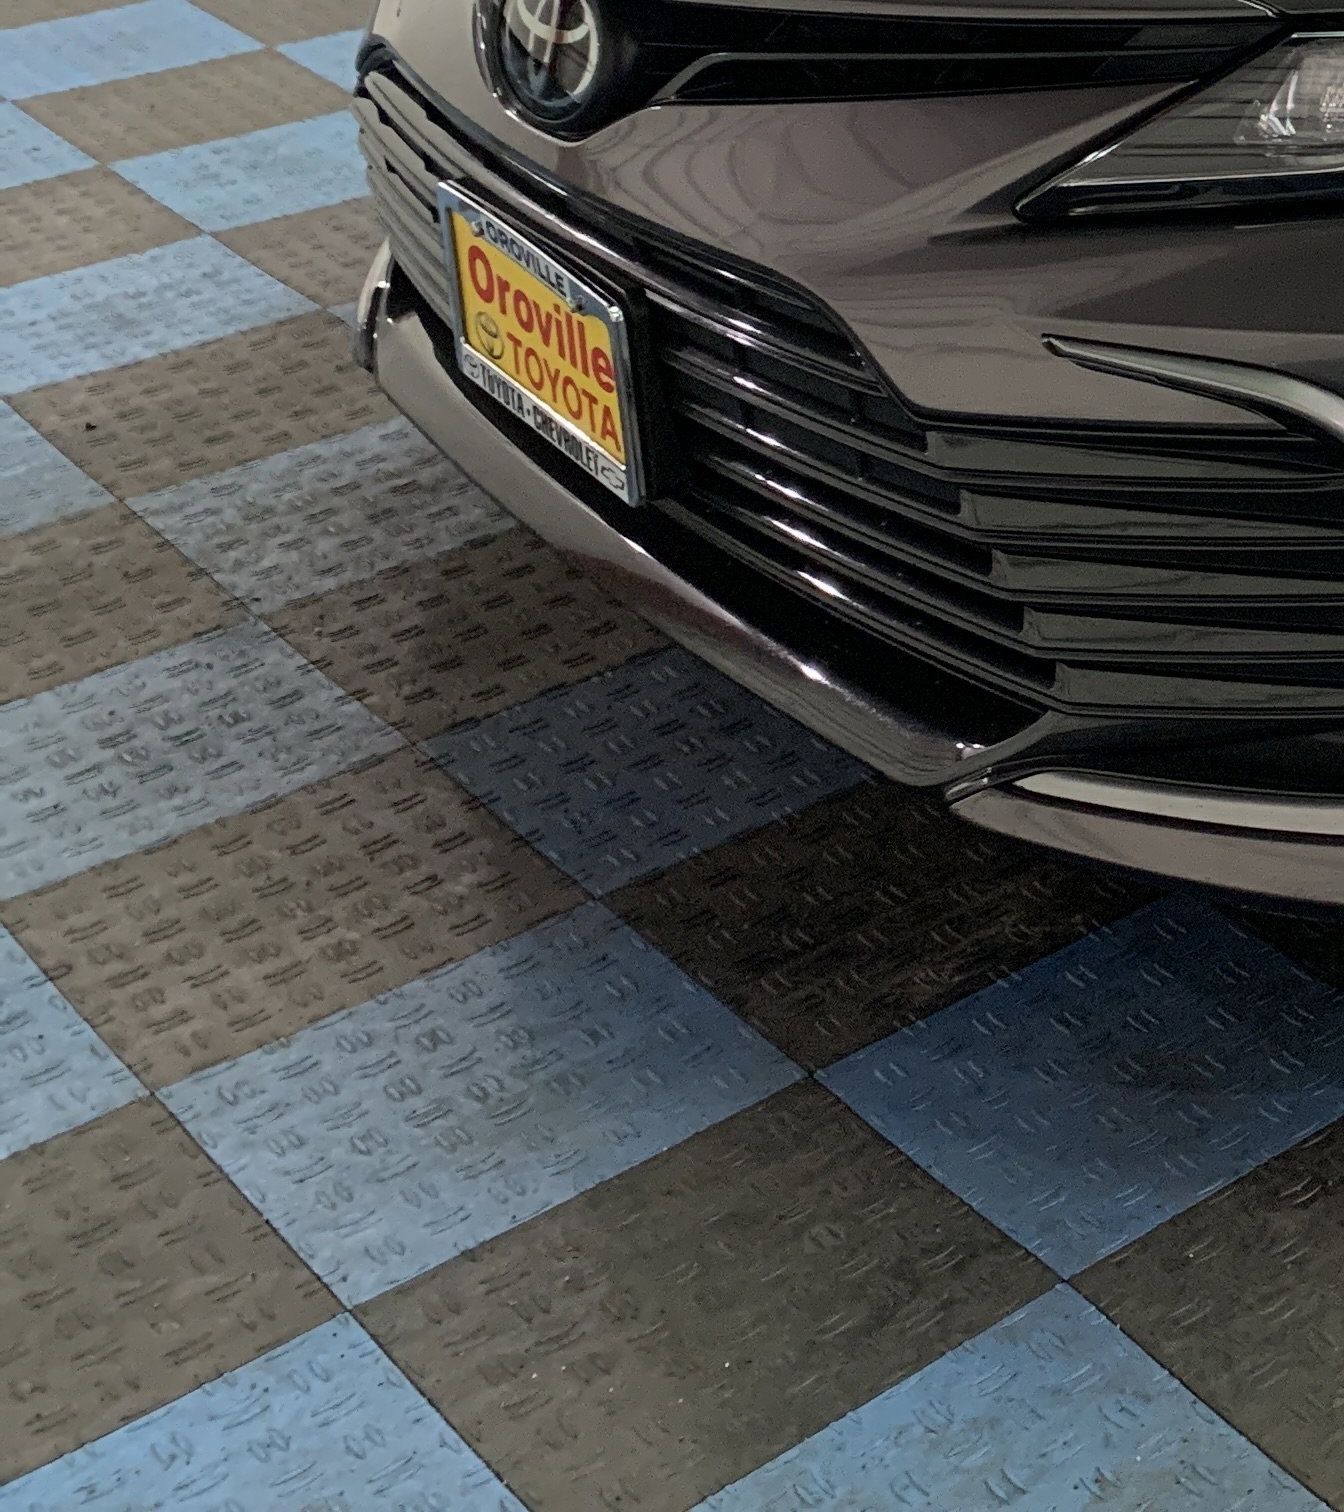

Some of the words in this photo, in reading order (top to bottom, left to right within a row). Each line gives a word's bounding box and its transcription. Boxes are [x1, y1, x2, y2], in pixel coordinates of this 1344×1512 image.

[485, 220, 568, 297] OROVILLE
[467, 244, 616, 394] Oroville
[478, 362, 525, 419] TOYOTA
[533, 404, 601, 477] CHEVROLET
[506, 331, 622, 453] TOYOTA
